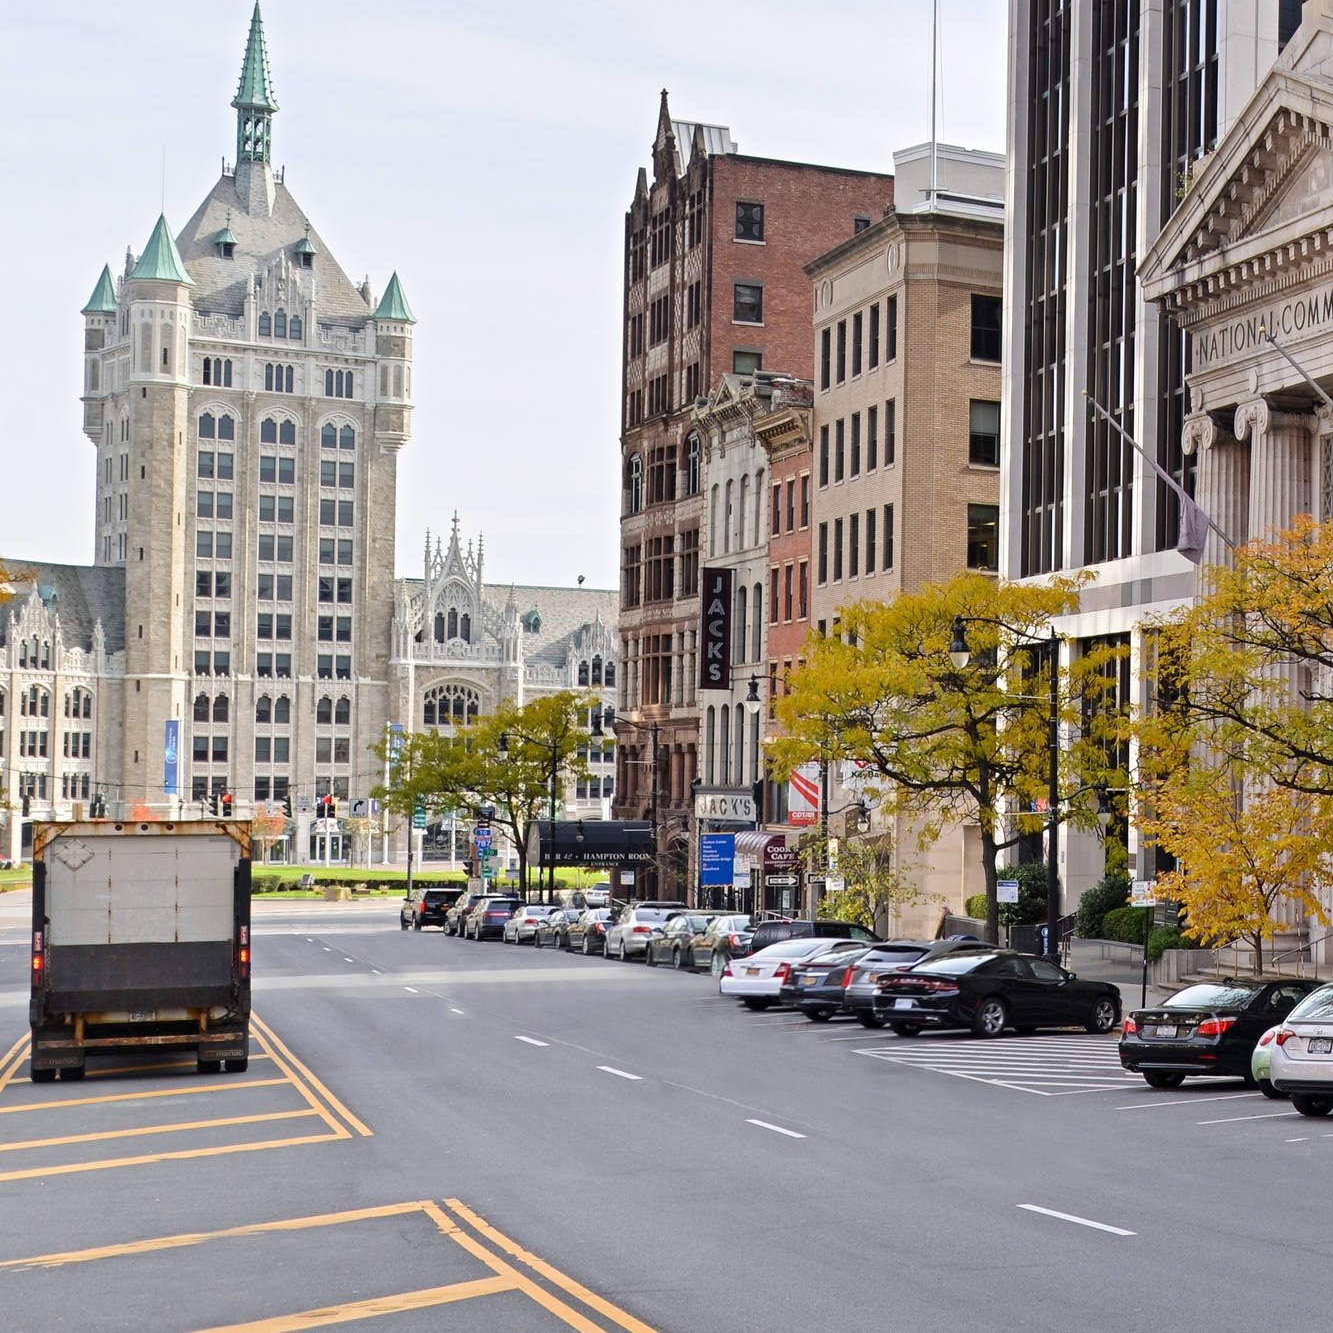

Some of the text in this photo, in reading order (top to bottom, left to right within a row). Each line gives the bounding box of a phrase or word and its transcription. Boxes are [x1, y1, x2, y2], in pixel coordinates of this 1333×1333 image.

[1200, 311, 1277, 364] NATIONAL
[707, 576, 726, 681] JACKS
[700, 796, 751, 816] JACK'S
[476, 840, 491, 848] 787
